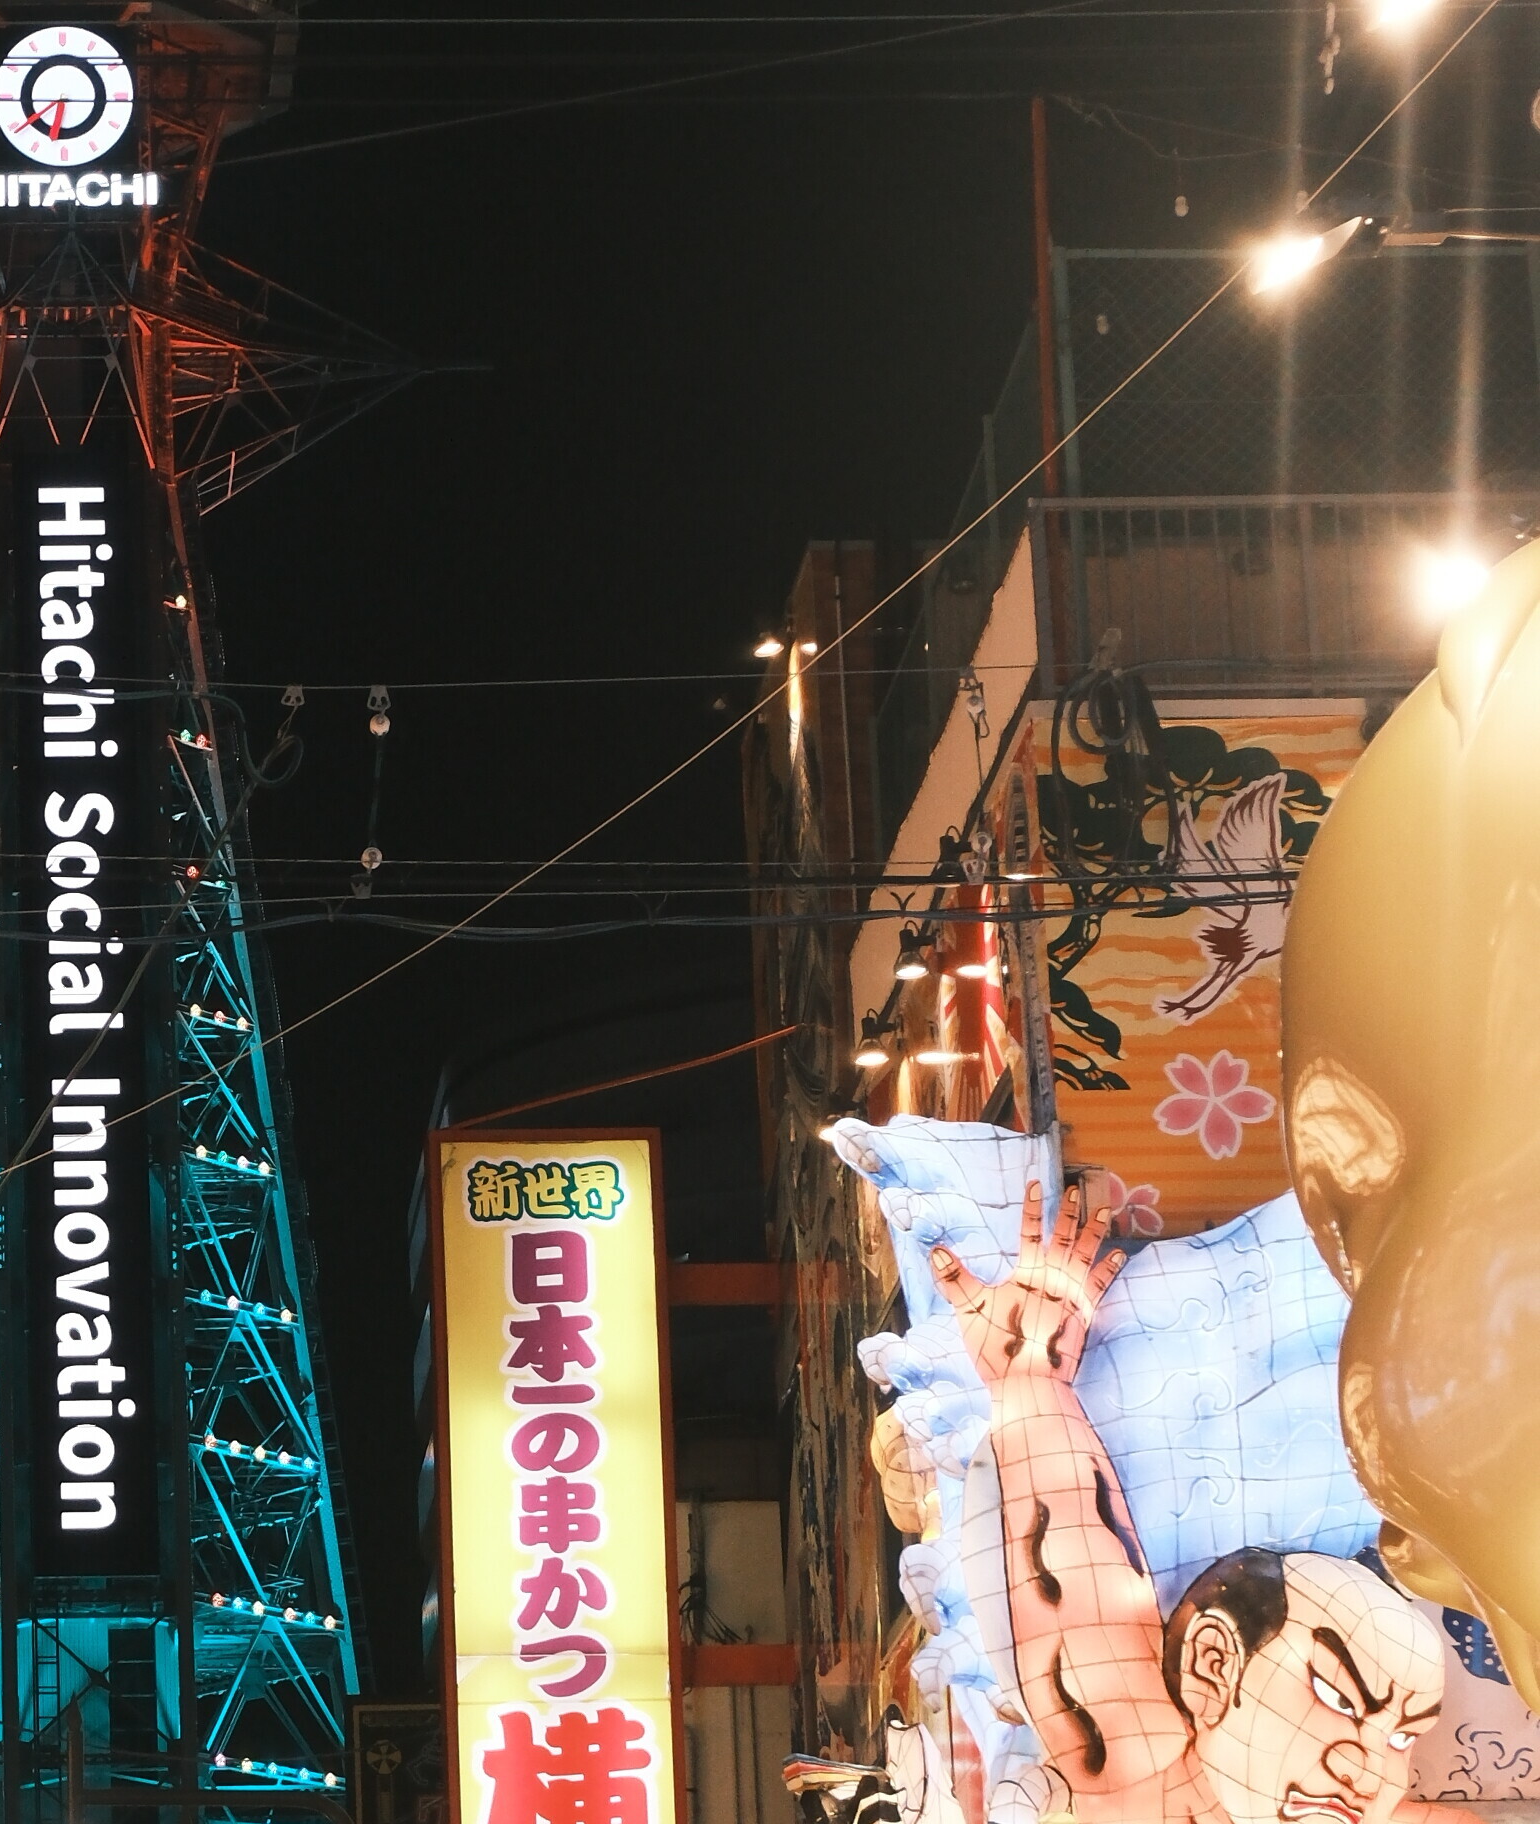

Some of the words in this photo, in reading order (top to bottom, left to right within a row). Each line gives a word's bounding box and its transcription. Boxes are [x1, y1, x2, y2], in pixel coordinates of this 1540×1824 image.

[36, 484, 115, 760] Hitachi
[44, 790, 125, 1034] Social
[48, 1072, 140, 1533] Innovation
[468, 1161, 623, 1222] 新世界
[502, 1228, 610, 1701] 日本一の串かつ
